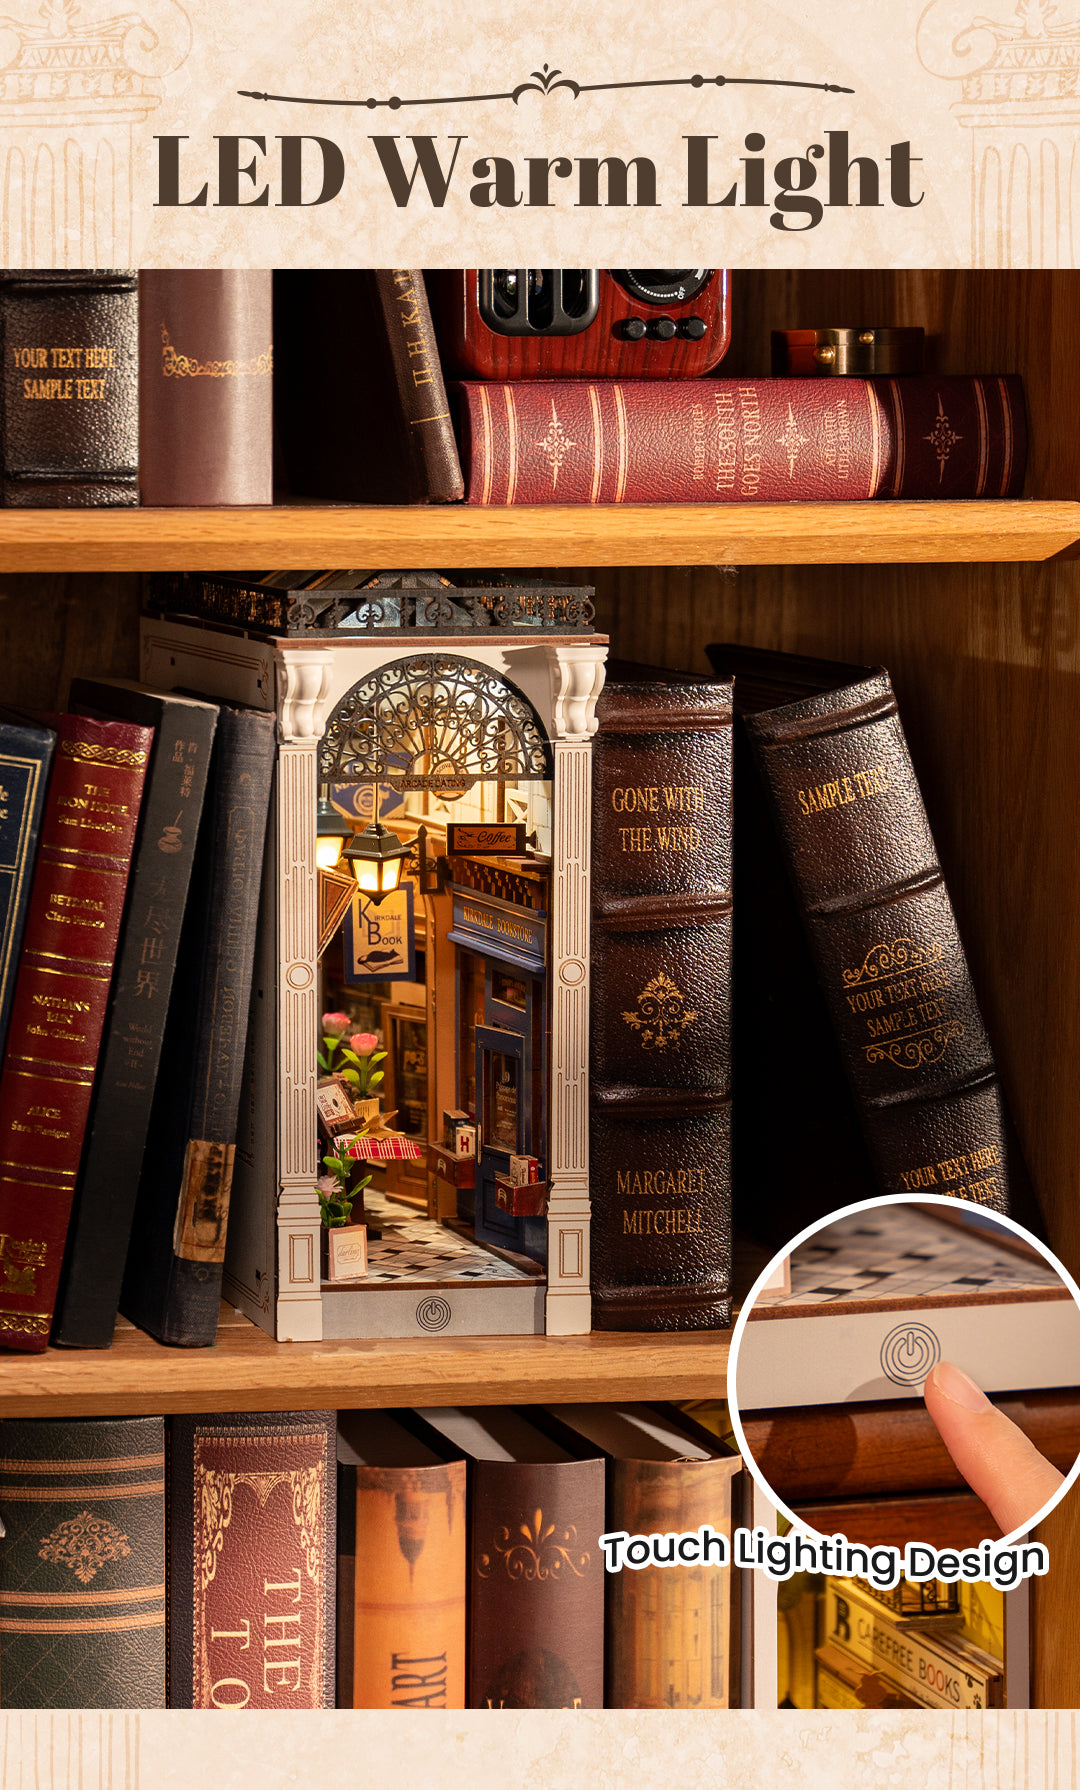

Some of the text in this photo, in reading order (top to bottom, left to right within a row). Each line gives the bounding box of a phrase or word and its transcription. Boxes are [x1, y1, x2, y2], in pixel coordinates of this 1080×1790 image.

[13, 347, 116, 368] YOUR TEXT HERE
[23, 379, 105, 400] SAMPLE TEXT
[837, 399, 849, 440] BROWN
[715, 392, 736, 490] THE SOUTH
[739, 387, 761, 496] GOES NORTH
[84, 783, 112, 798] THE
[401, 779, 466, 788] ARCADE DATING
[612, 787, 705, 812] GONE WITH
[798, 766, 889, 815] SAMPLE TEXT
[477, 830, 512, 845] Coffee
[619, 827, 700, 852] THE WIND
[463, 905, 533, 944] KIRKDALE BOOKSTORE
[846, 966, 950, 1014] YOUR TEXT HERE
[866, 998, 946, 1038] SAMPLE TEXT
[26, 1106, 62, 1119] ALICE
[616, 1168, 706, 1195] MARGARET
[901, 1145, 1001, 1191] YOUR TEXT HERE
[968, 1177, 1000, 1203] TEXT
[623, 1208, 704, 1235] MITCHELL
[263, 1568, 302, 1694] THE
[857, 1617, 914, 1673] CAREFREE
[918, 1657, 960, 1702] BOOKS
[391, 1650, 448, 1709] ART
